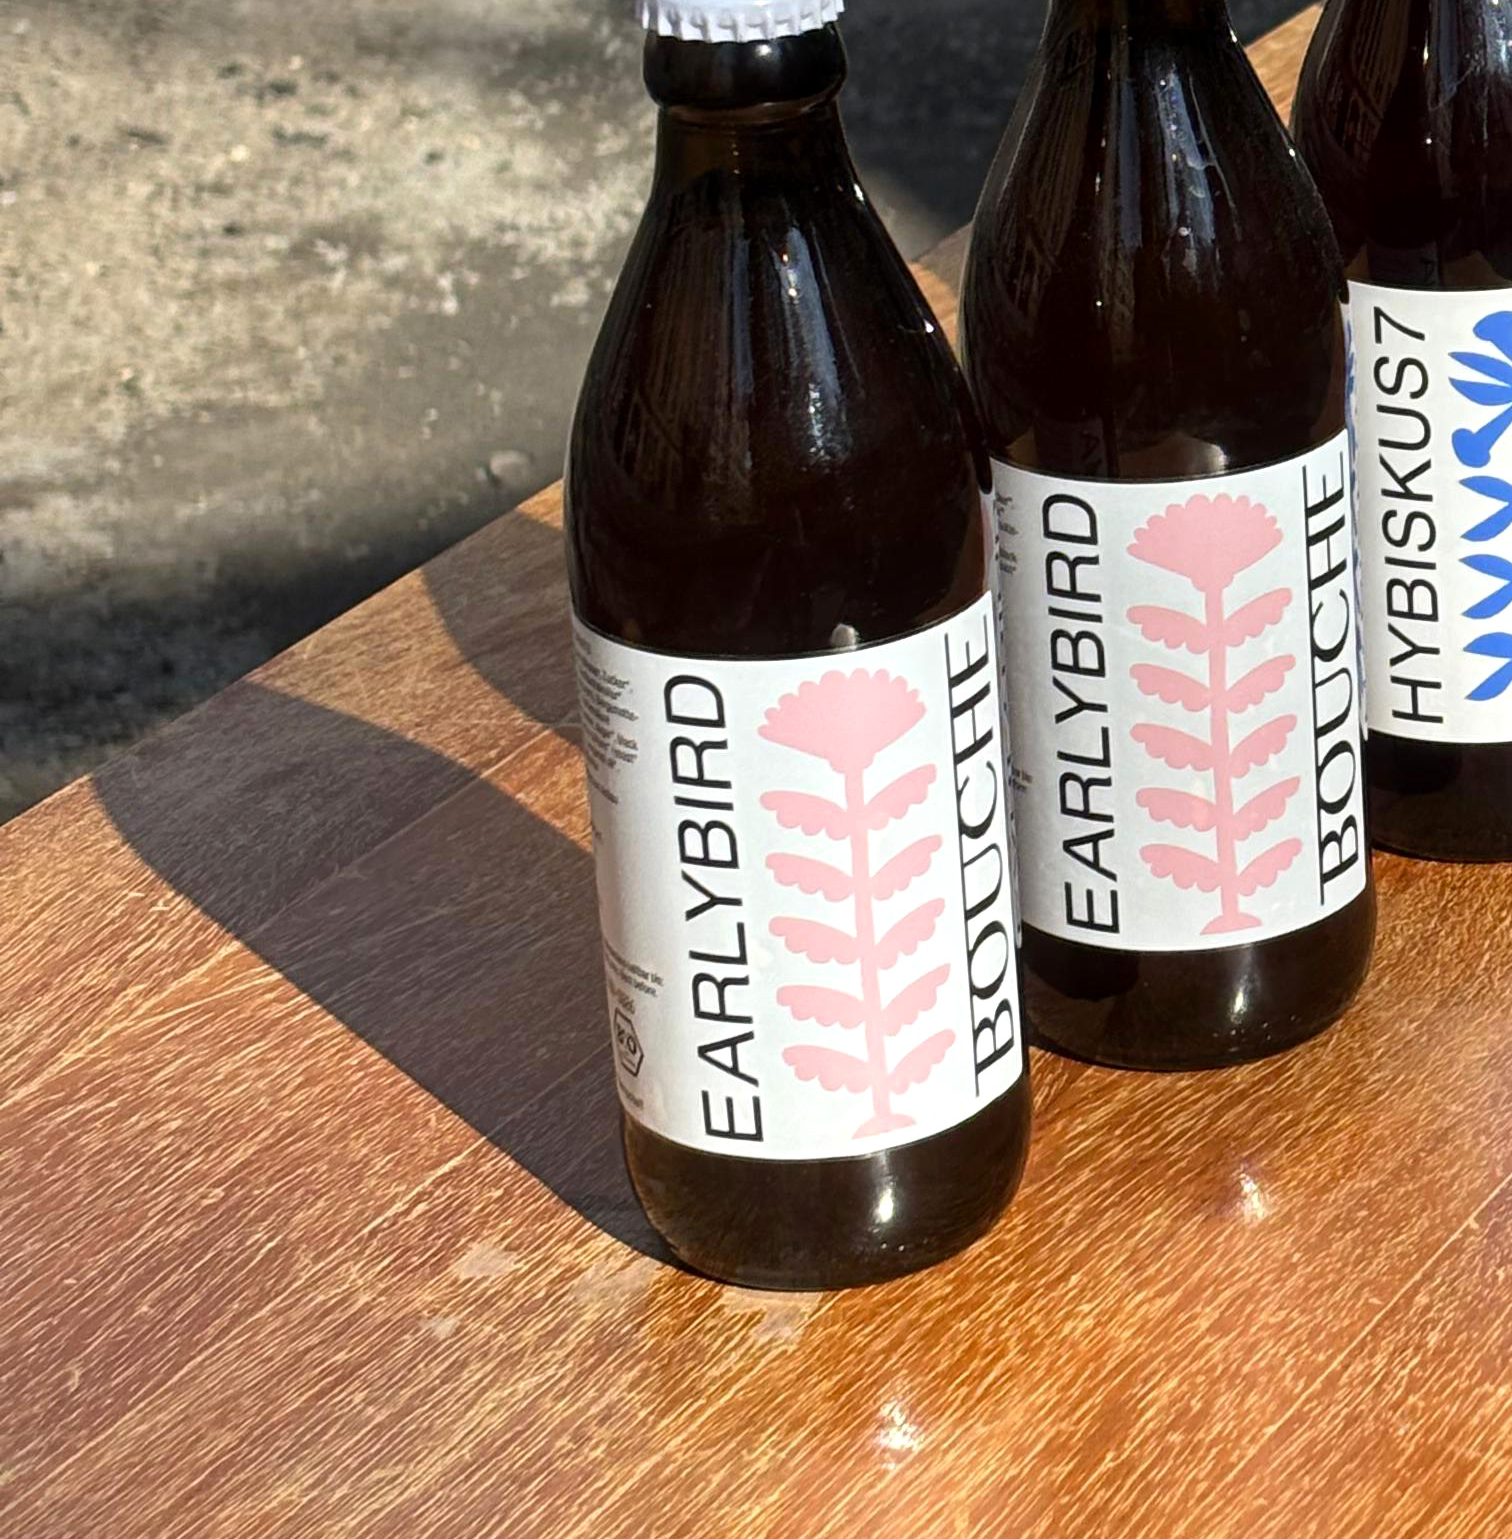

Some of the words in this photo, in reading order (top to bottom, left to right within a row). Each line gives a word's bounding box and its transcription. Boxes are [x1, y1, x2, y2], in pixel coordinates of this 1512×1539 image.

[1042, 493, 1120, 933] EARLYBIRD
[1301, 452, 1360, 905] BOUCHE
[1373, 306, 1444, 724] HYBISKUS7
[663, 674, 764, 1143] EARLYBIRD
[944, 614, 1016, 1097] BOUCHE
